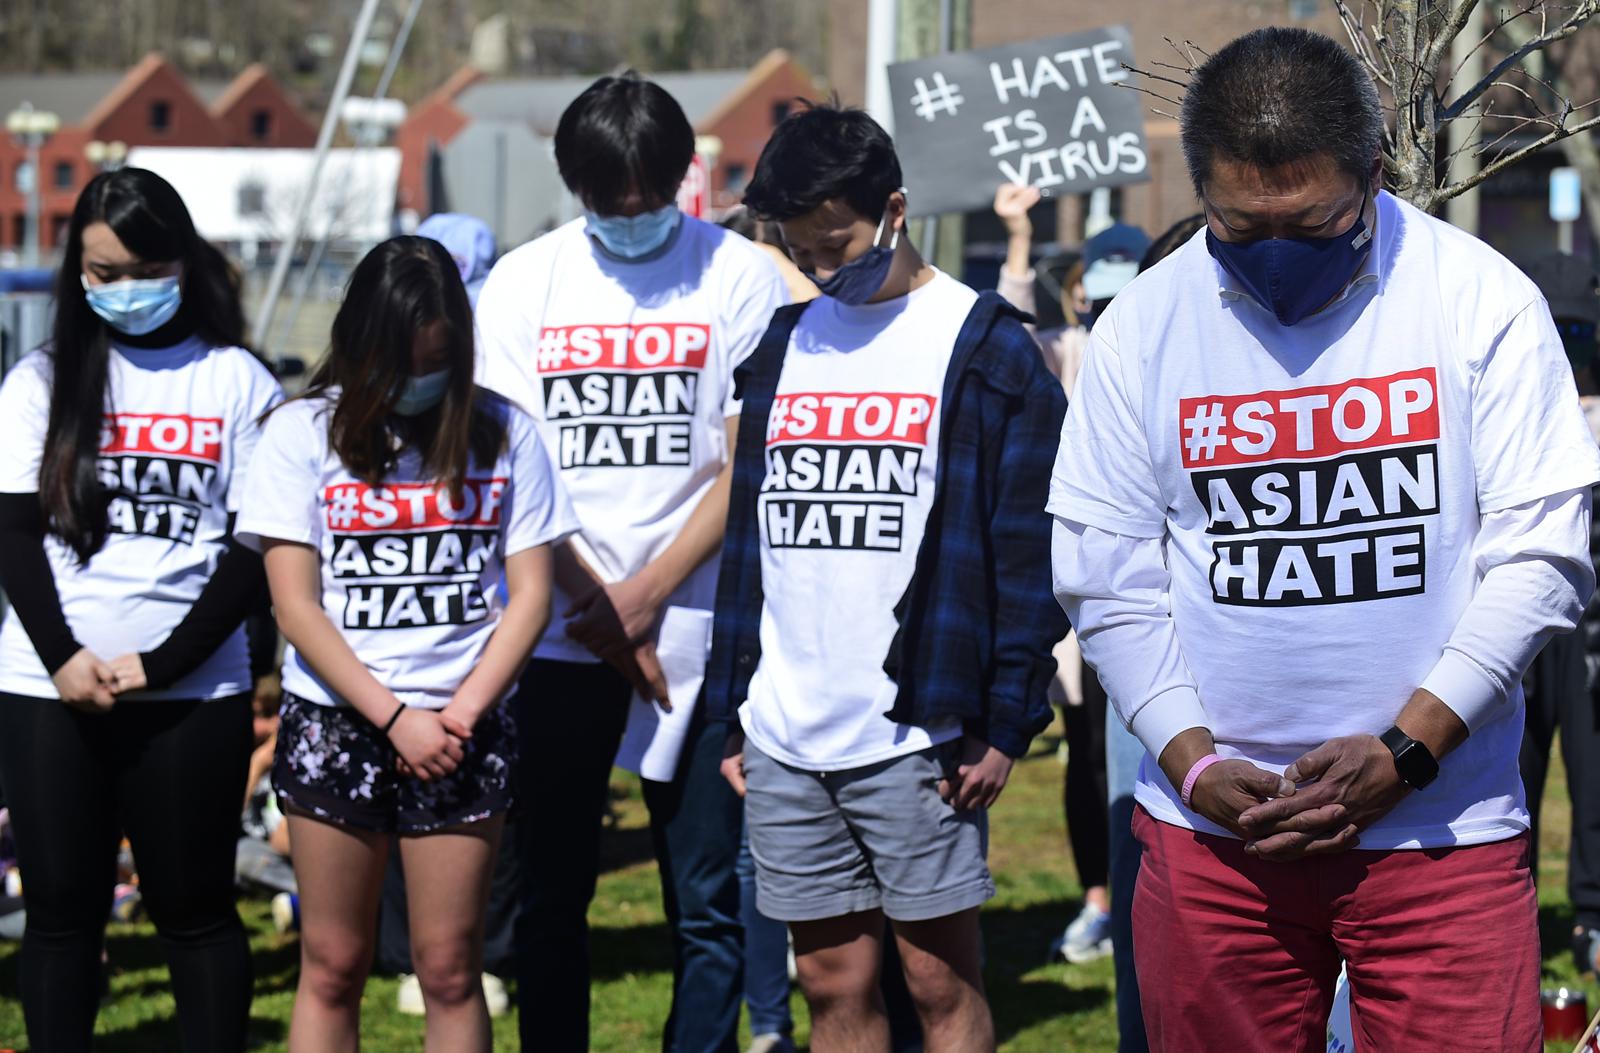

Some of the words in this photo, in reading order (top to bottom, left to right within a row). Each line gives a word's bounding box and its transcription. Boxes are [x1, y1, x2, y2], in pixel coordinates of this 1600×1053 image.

[910, 71, 965, 122] #
[989, 40, 1129, 104] HATE
[982, 109, 1048, 157] IS
[1069, 96, 1107, 138] A
[998, 132, 1147, 188] VIRUS
[538, 325, 707, 370] #STOP
[546, 373, 697, 419] ASIAN
[766, 395, 931, 441] #STOP
[1183, 377, 1434, 461] #STOP
[100, 415, 222, 455] TOP
[561, 424, 689, 468] HATE
[98, 457, 215, 507] SIAN
[760, 446, 921, 494] ASIAN
[1207, 452, 1437, 530] ASIAN
[107, 497, 198, 545] ATE
[328, 481, 505, 529] #STOP
[766, 502, 901, 549] HATE
[332, 533, 498, 577] ASIAN
[1213, 531, 1422, 600] HATE
[345, 583, 488, 628] HATE
